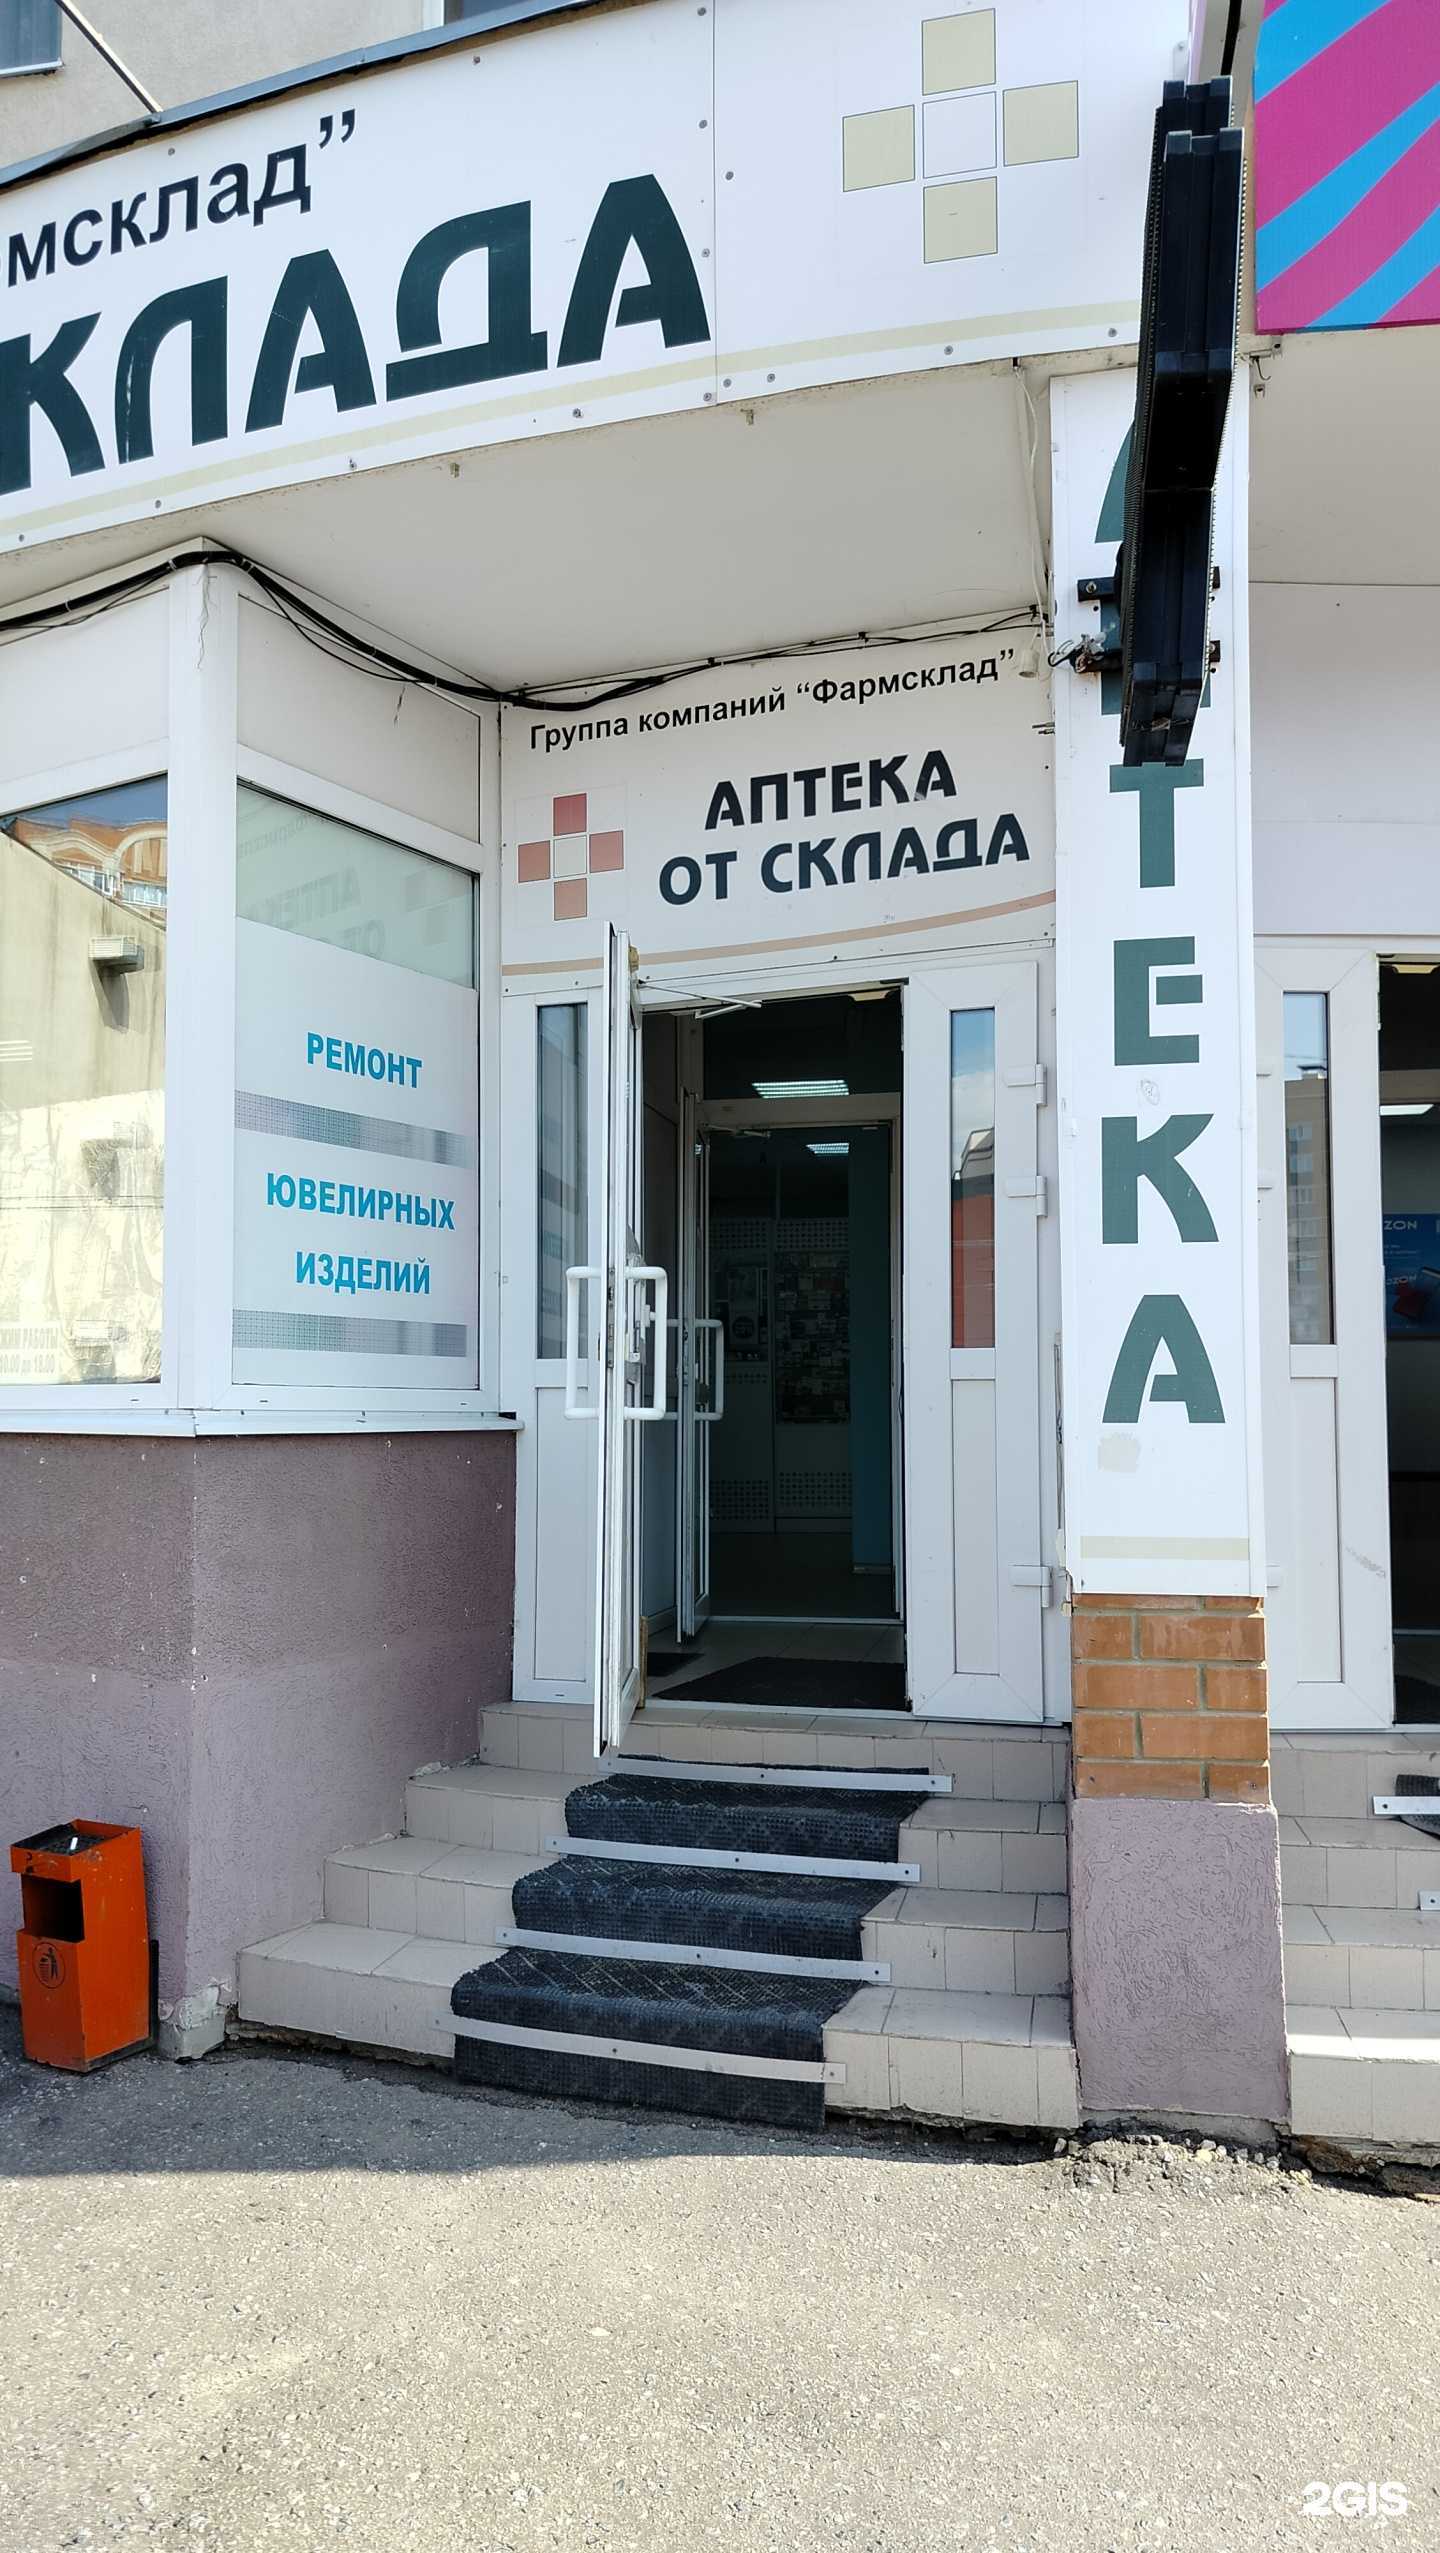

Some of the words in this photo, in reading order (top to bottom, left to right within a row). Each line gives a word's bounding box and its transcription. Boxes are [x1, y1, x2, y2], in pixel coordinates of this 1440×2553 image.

[0, 173, 711, 497] КЛАДА
[529, 721, 629, 753] Группа
[638, 686, 786, 732] компаний
[797, 648, 1014, 704] “Фармсклад”
[704, 749, 958, 831] АПТЕКА
[659, 850, 738, 906] ОТ
[760, 812, 1031, 893] СКЛАДА
[1094, 418, 1226, 1424] ТЕКА
[306, 1031, 424, 1089] РЕМОНТ
[265, 1172, 456, 1231] ЮВЕЛИРНЫХ
[295, 1250, 432, 1296] ИЗДЕЛИЙ
